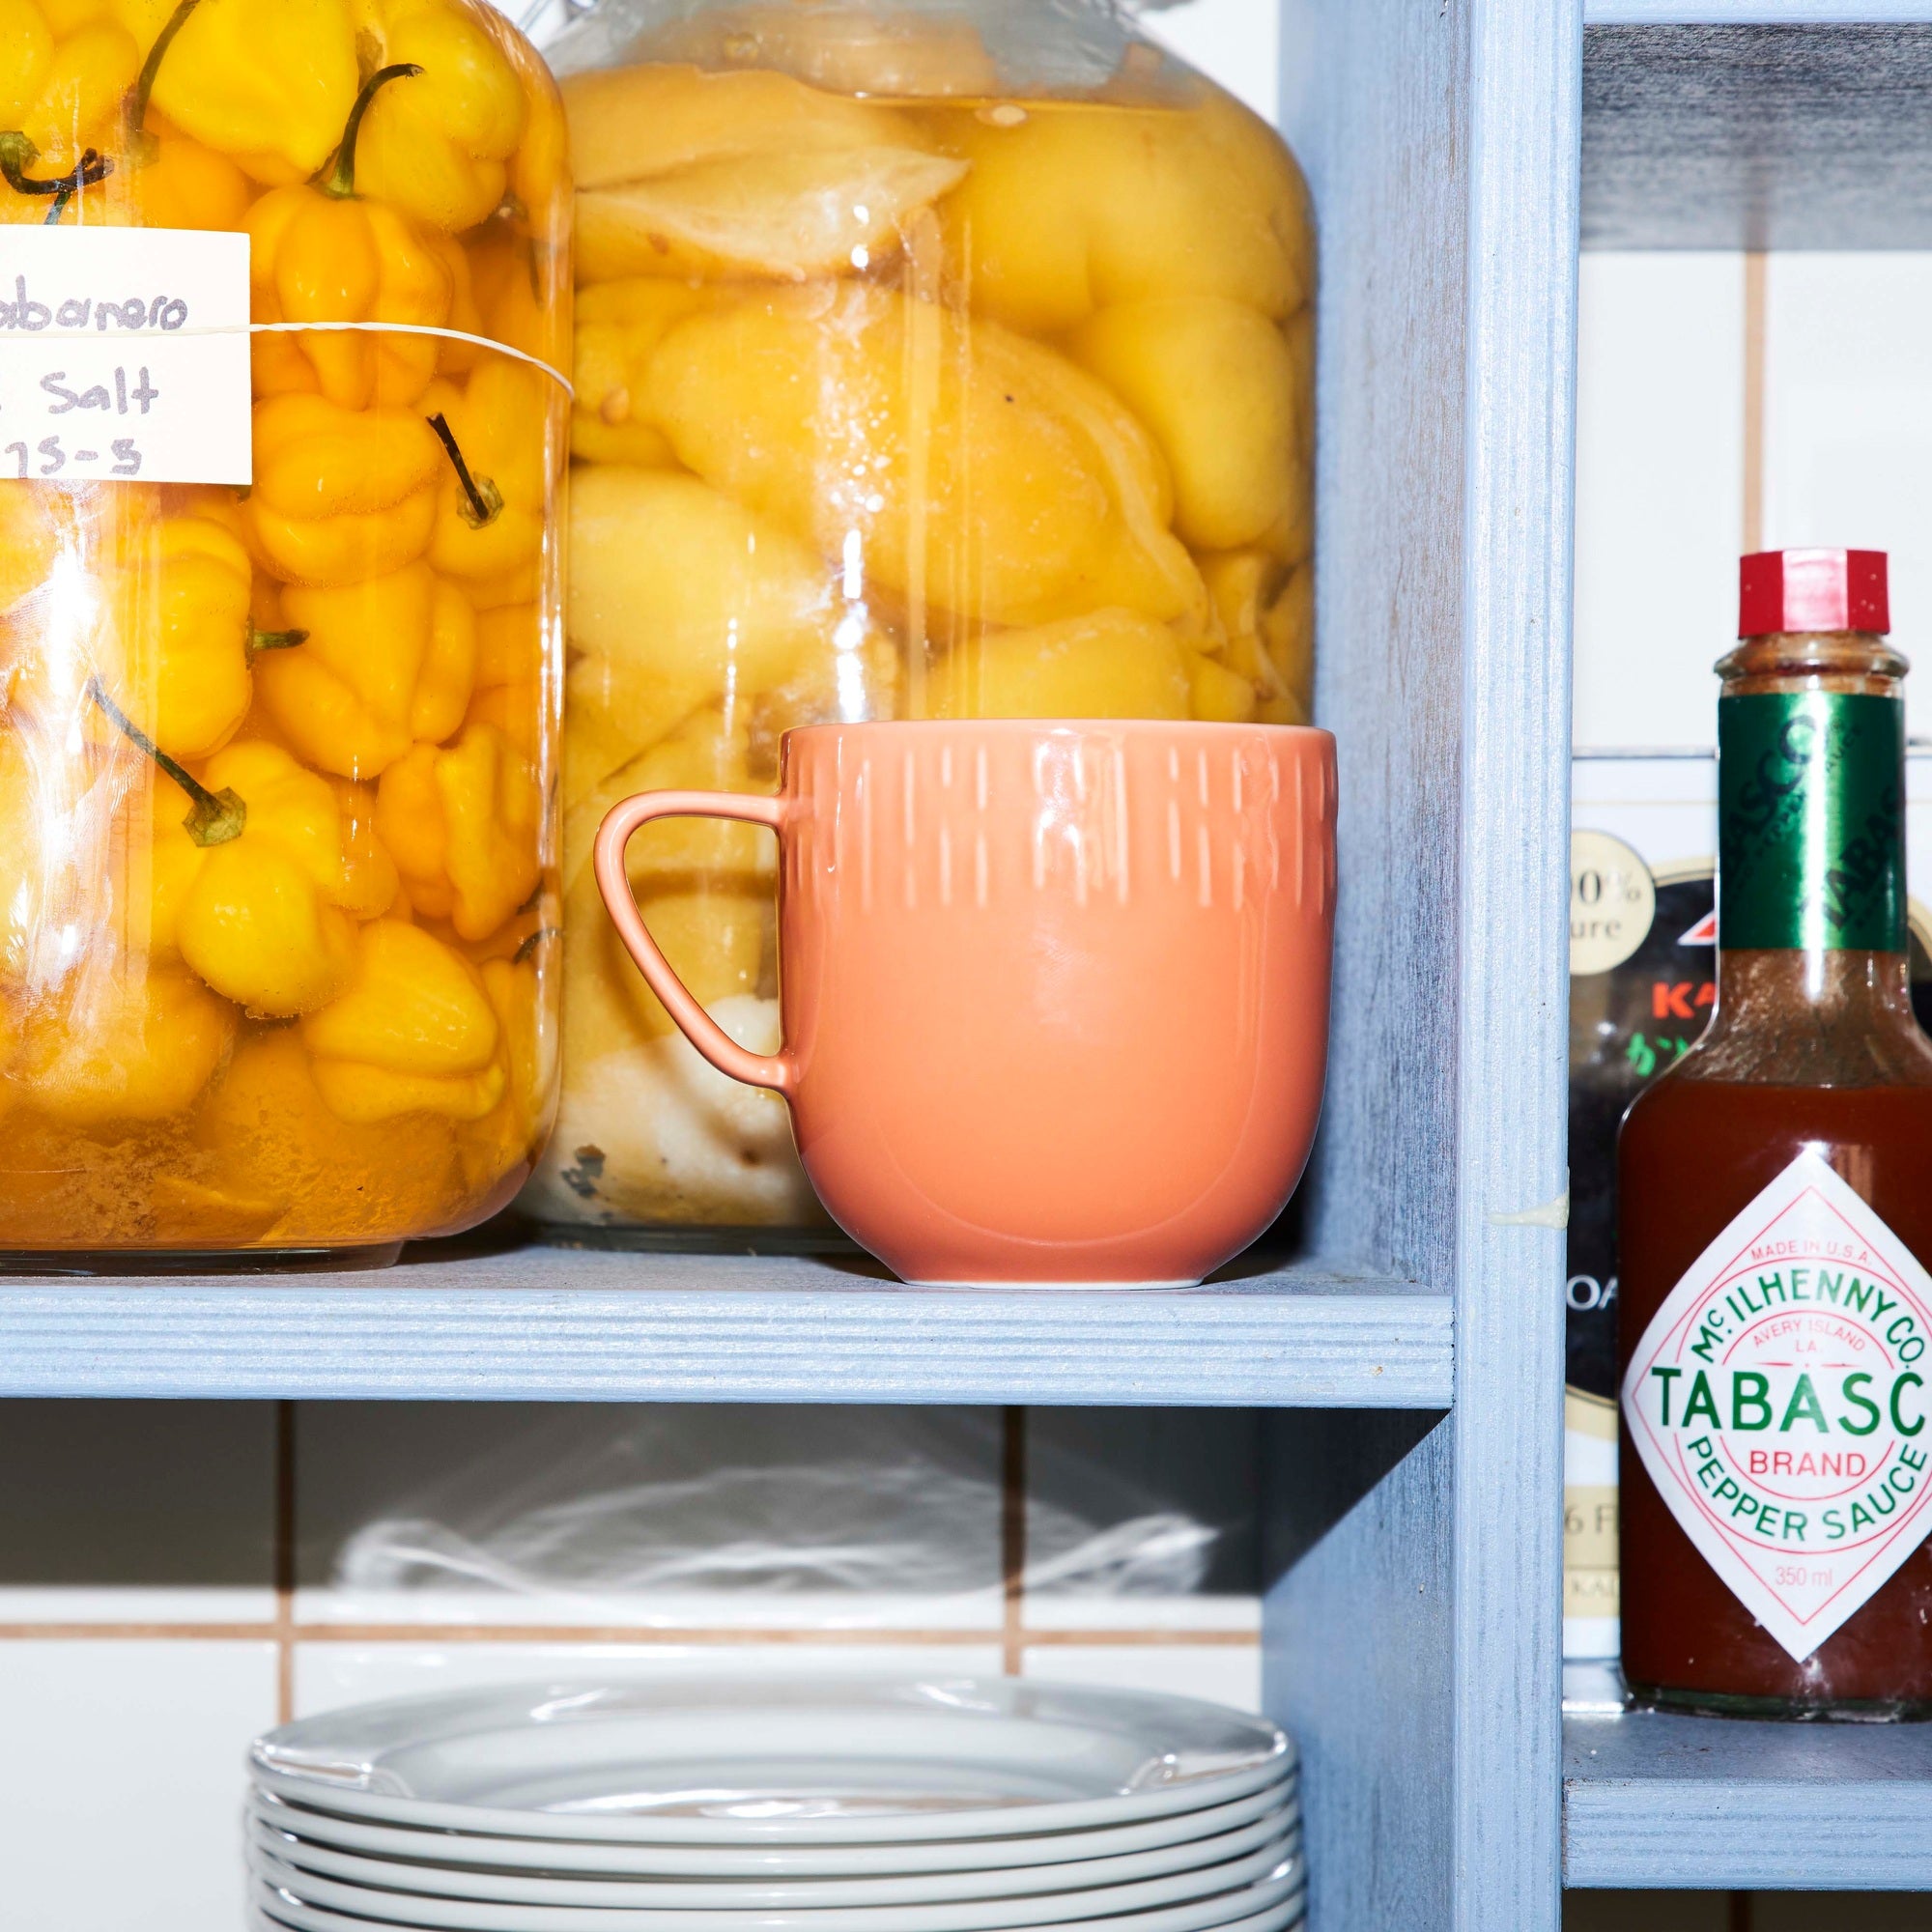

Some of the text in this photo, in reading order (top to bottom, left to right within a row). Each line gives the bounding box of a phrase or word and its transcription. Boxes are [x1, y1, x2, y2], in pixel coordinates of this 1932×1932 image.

[40, 366, 159, 414] Salt
[1571, 869, 1641, 906] 0%
[1750, 1240, 1873, 1266] MADE IN U.S.A.
[1753, 1320, 1866, 1353] AVERY ISLAND
[1651, 1366, 1926, 1436] TABASC
[1749, 1450, 1867, 1477] BRAND
[1687, 1435, 1928, 1542] PEPPER SAUCE
[1775, 1566, 1833, 1587] 350 ml
